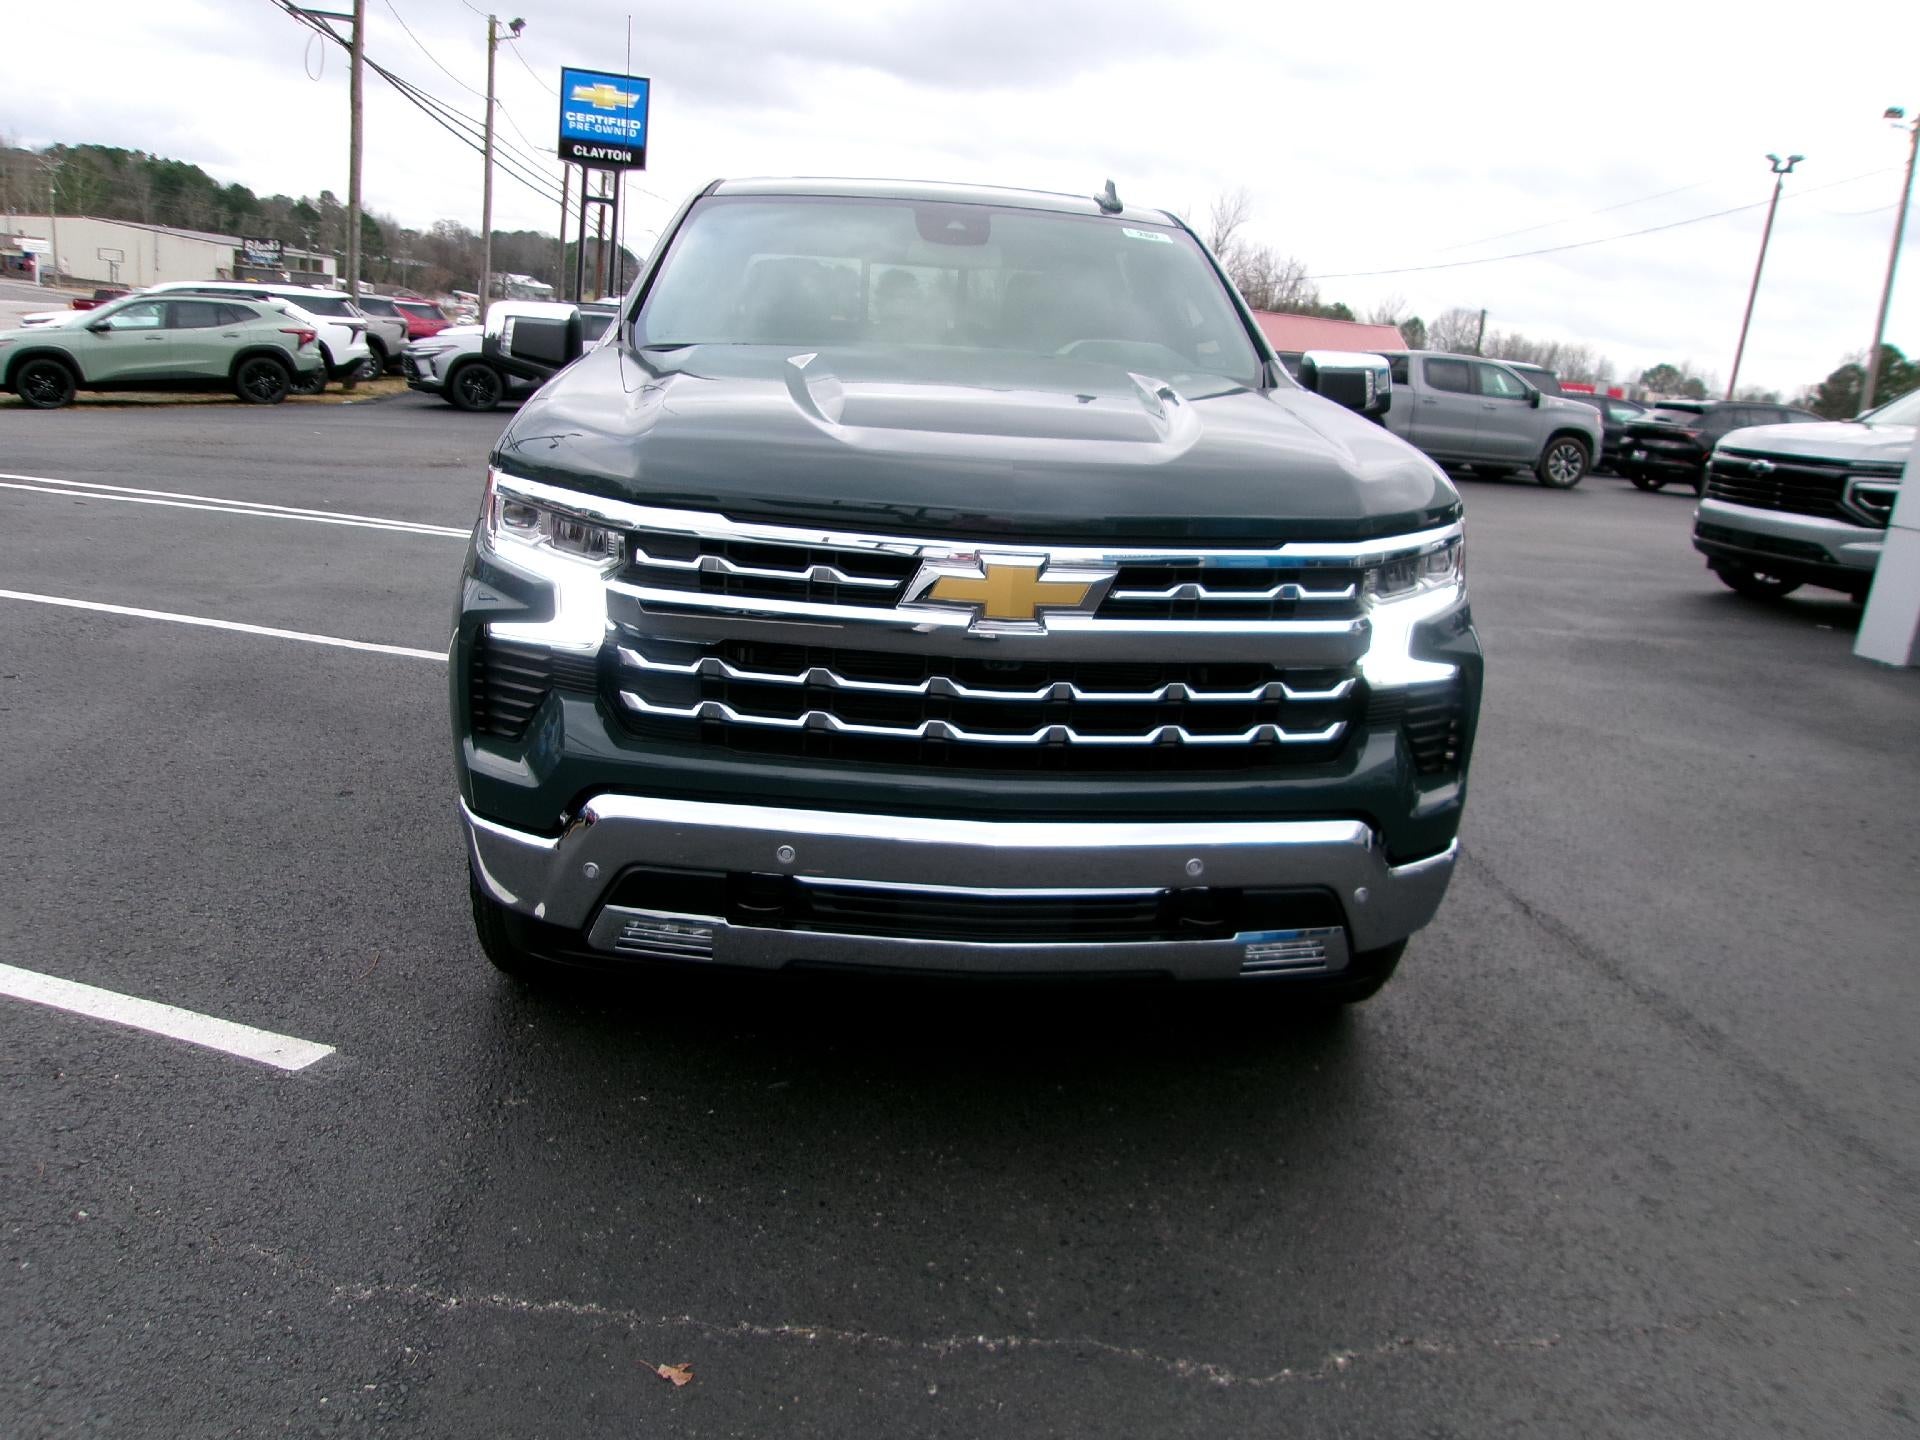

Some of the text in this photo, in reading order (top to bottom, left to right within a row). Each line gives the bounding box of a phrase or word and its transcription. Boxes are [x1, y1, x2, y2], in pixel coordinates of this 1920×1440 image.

[565, 111, 641, 129] CERTIFIED
[569, 121, 637, 137] PRE-OWNED
[573, 145, 632, 162] CLAYTON
